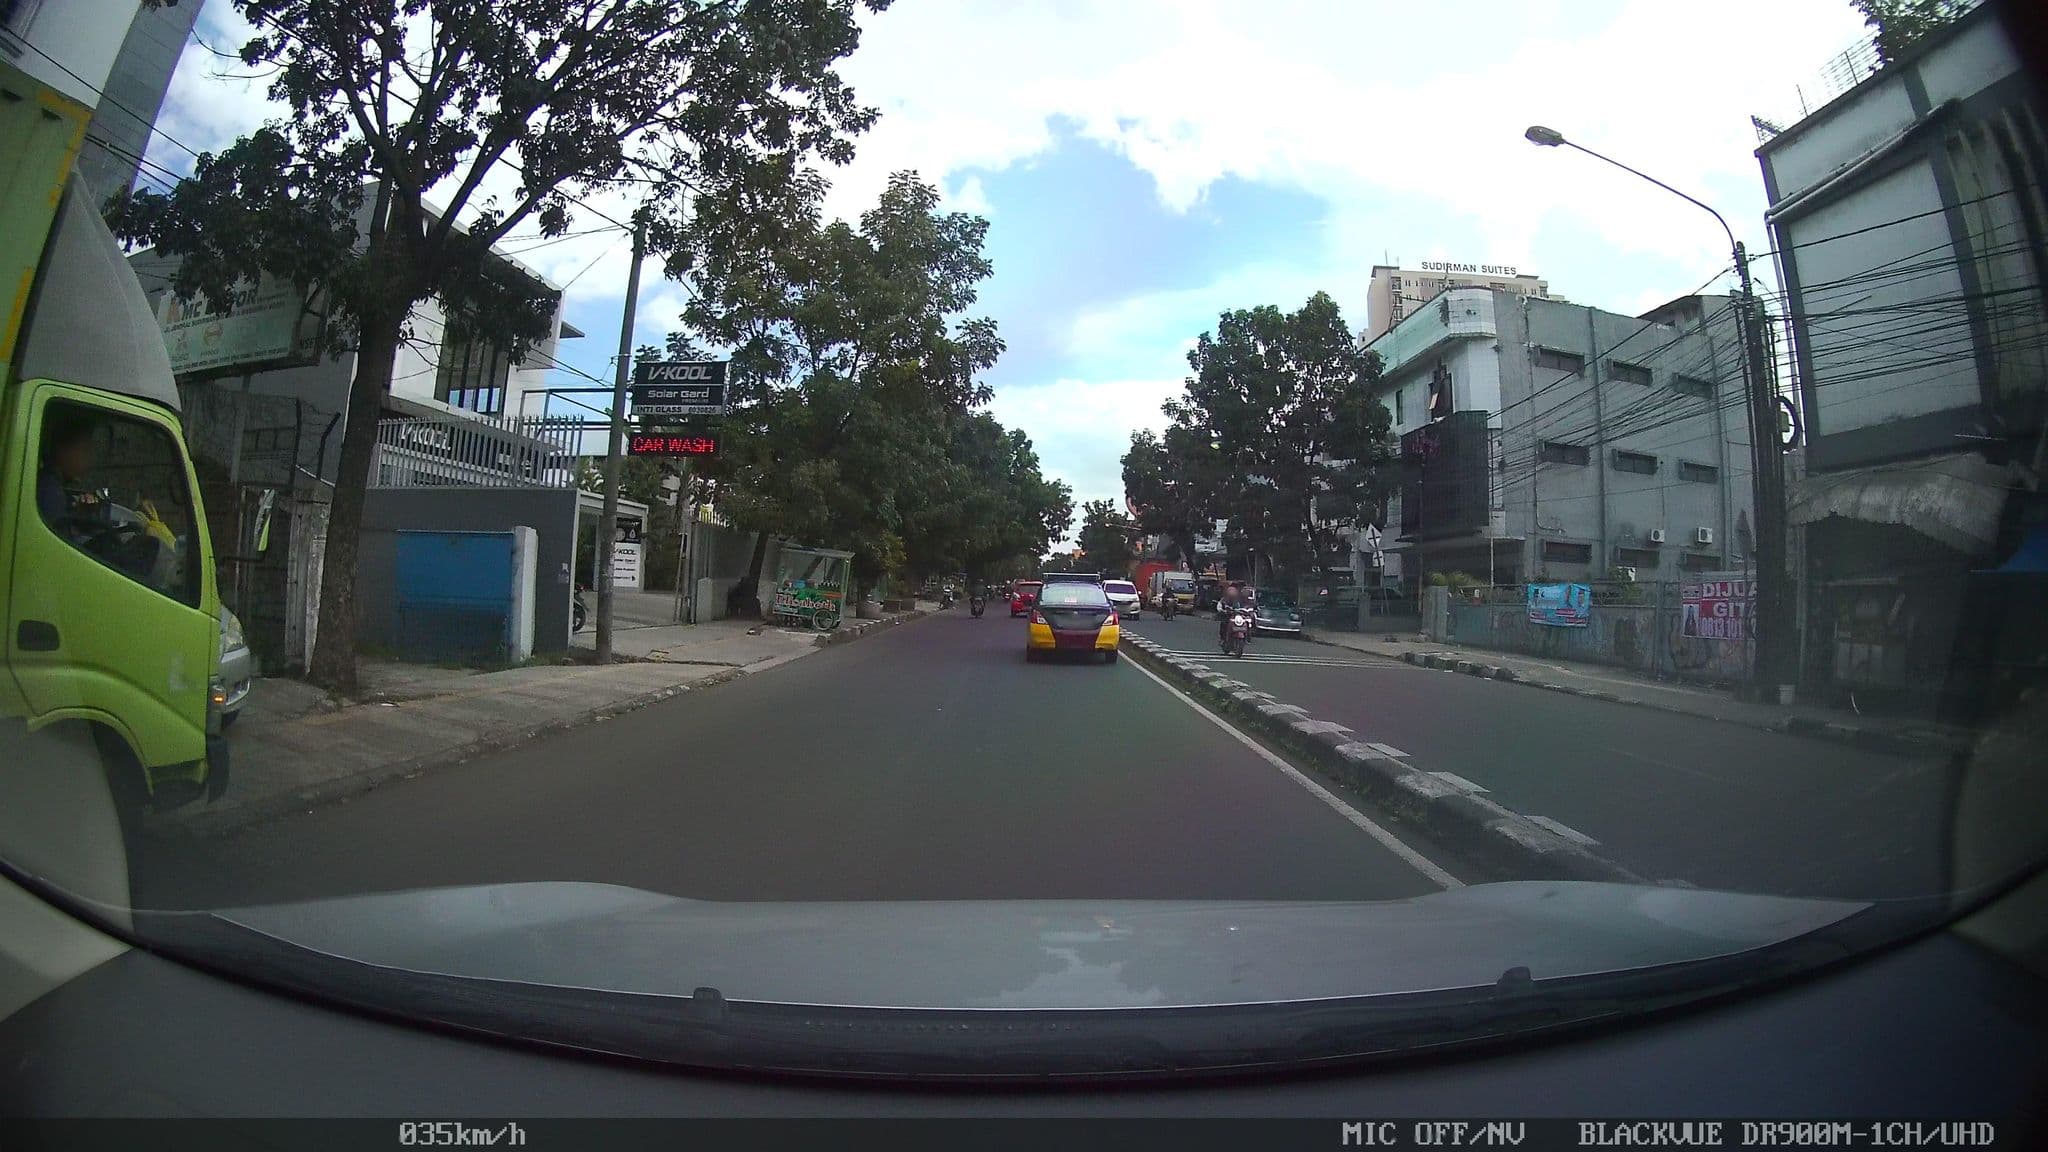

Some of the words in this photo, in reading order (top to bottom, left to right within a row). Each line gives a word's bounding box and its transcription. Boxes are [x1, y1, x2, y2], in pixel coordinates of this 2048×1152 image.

[1421, 261, 1477, 272] SUDIRMAN
[1481, 265, 1517, 275] SUITES
[648, 366, 712, 380] V-KOOL
[648, 389, 678, 398] Solar
[680, 387, 710, 398] Gard
[632, 437, 664, 452] CAR
[668, 437, 715, 453] WASH
[1702, 582, 1758, 598] DIJUA
